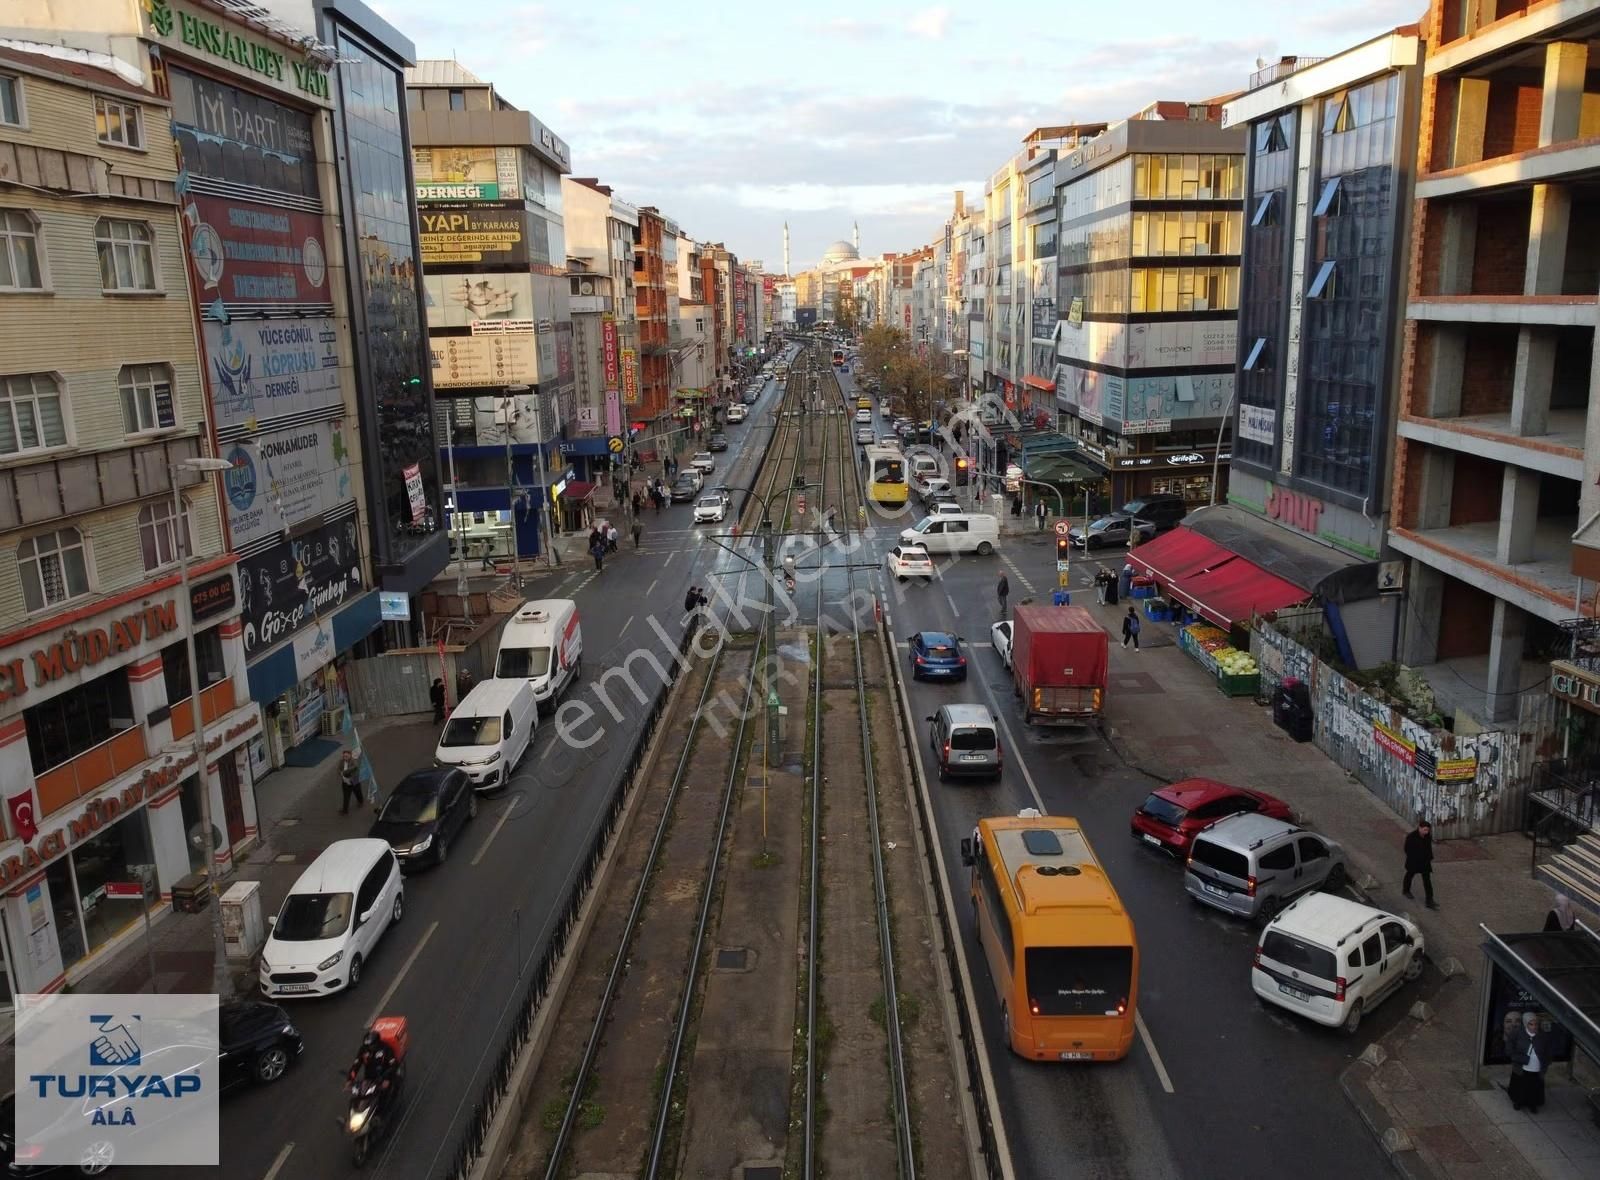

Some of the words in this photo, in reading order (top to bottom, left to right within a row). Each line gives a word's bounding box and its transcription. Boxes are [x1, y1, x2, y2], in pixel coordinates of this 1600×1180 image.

[178, 10, 284, 82] ENSARBEY
[422, 214, 469, 232] YAPI
[471, 222, 480, 230] BY
[483, 220, 520, 231] KARAKAŞ
[258, 326, 284, 346] YÜCE
[284, 324, 313, 344] GÖNÜL
[262, 345, 316, 377] KÖPRÜSÜ
[265, 376, 300, 398] DERNEĞİ
[261, 433, 319, 460] KONKAMUDER
[30, 600, 179, 689] MÜDAVİM
